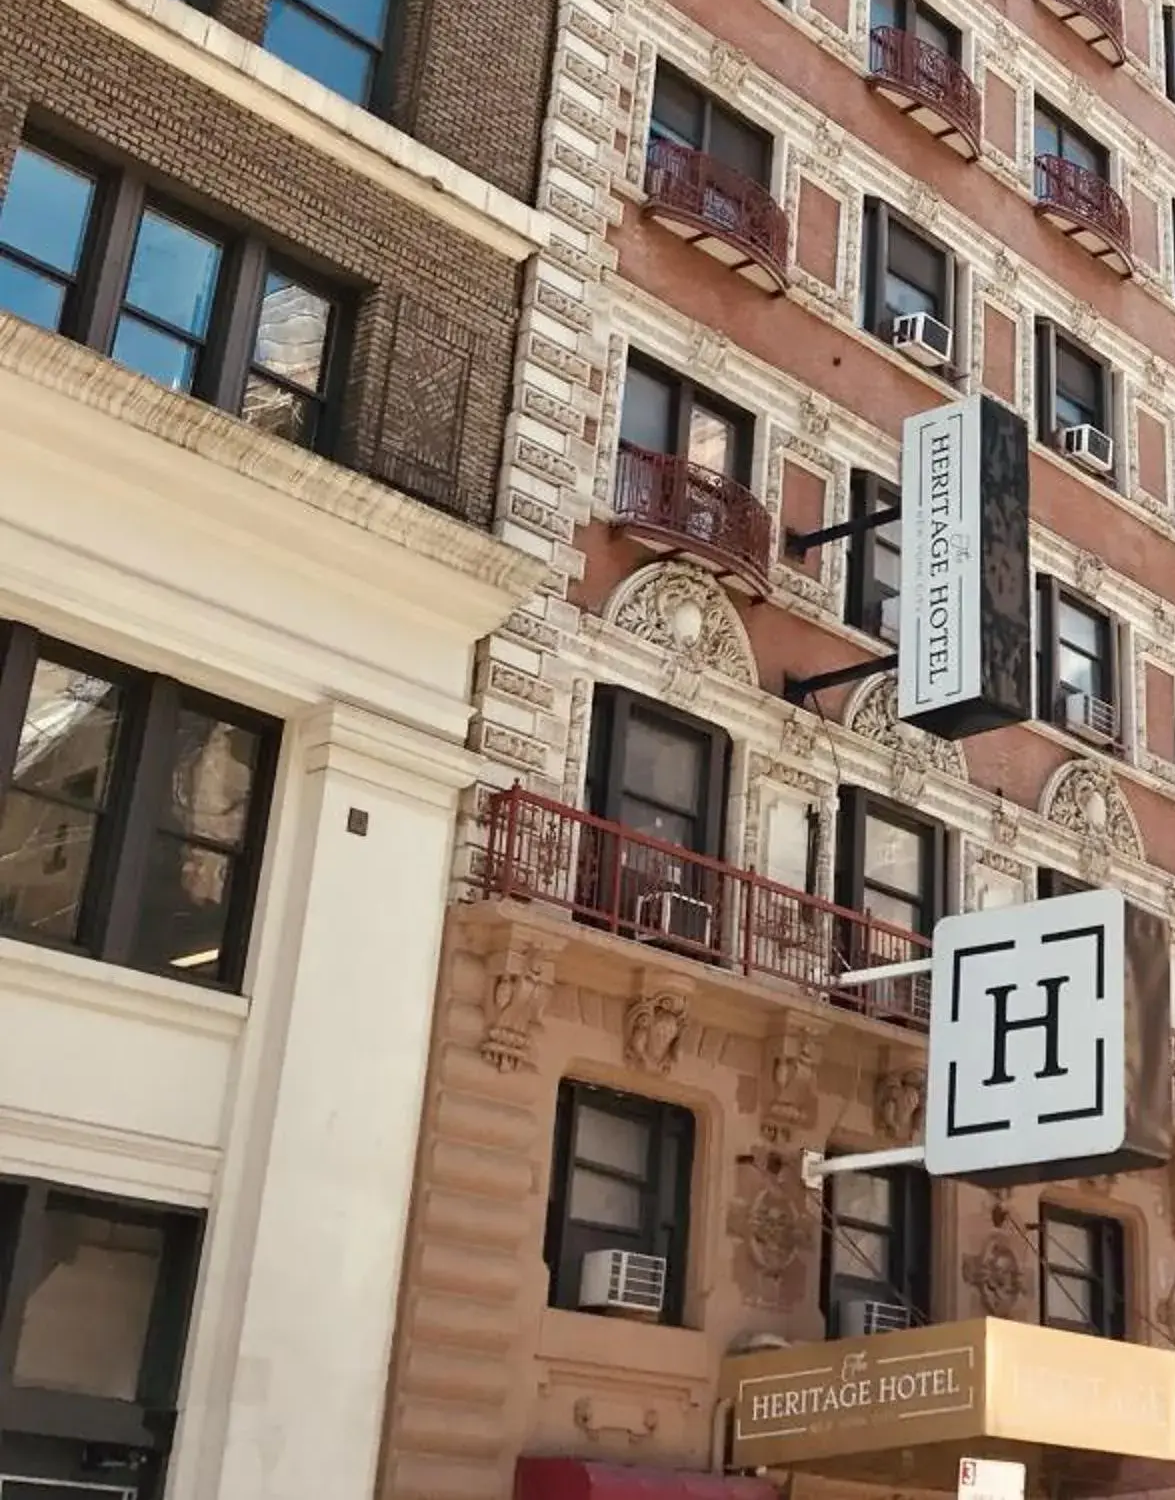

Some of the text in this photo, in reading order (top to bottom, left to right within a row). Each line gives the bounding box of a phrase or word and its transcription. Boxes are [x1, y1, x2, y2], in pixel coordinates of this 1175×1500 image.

[930, 433, 950, 685] HERITAGE HOTEL
[982, 975, 1070, 1087] H
[751, 1367, 960, 1421] HERITAGE HOTEL
